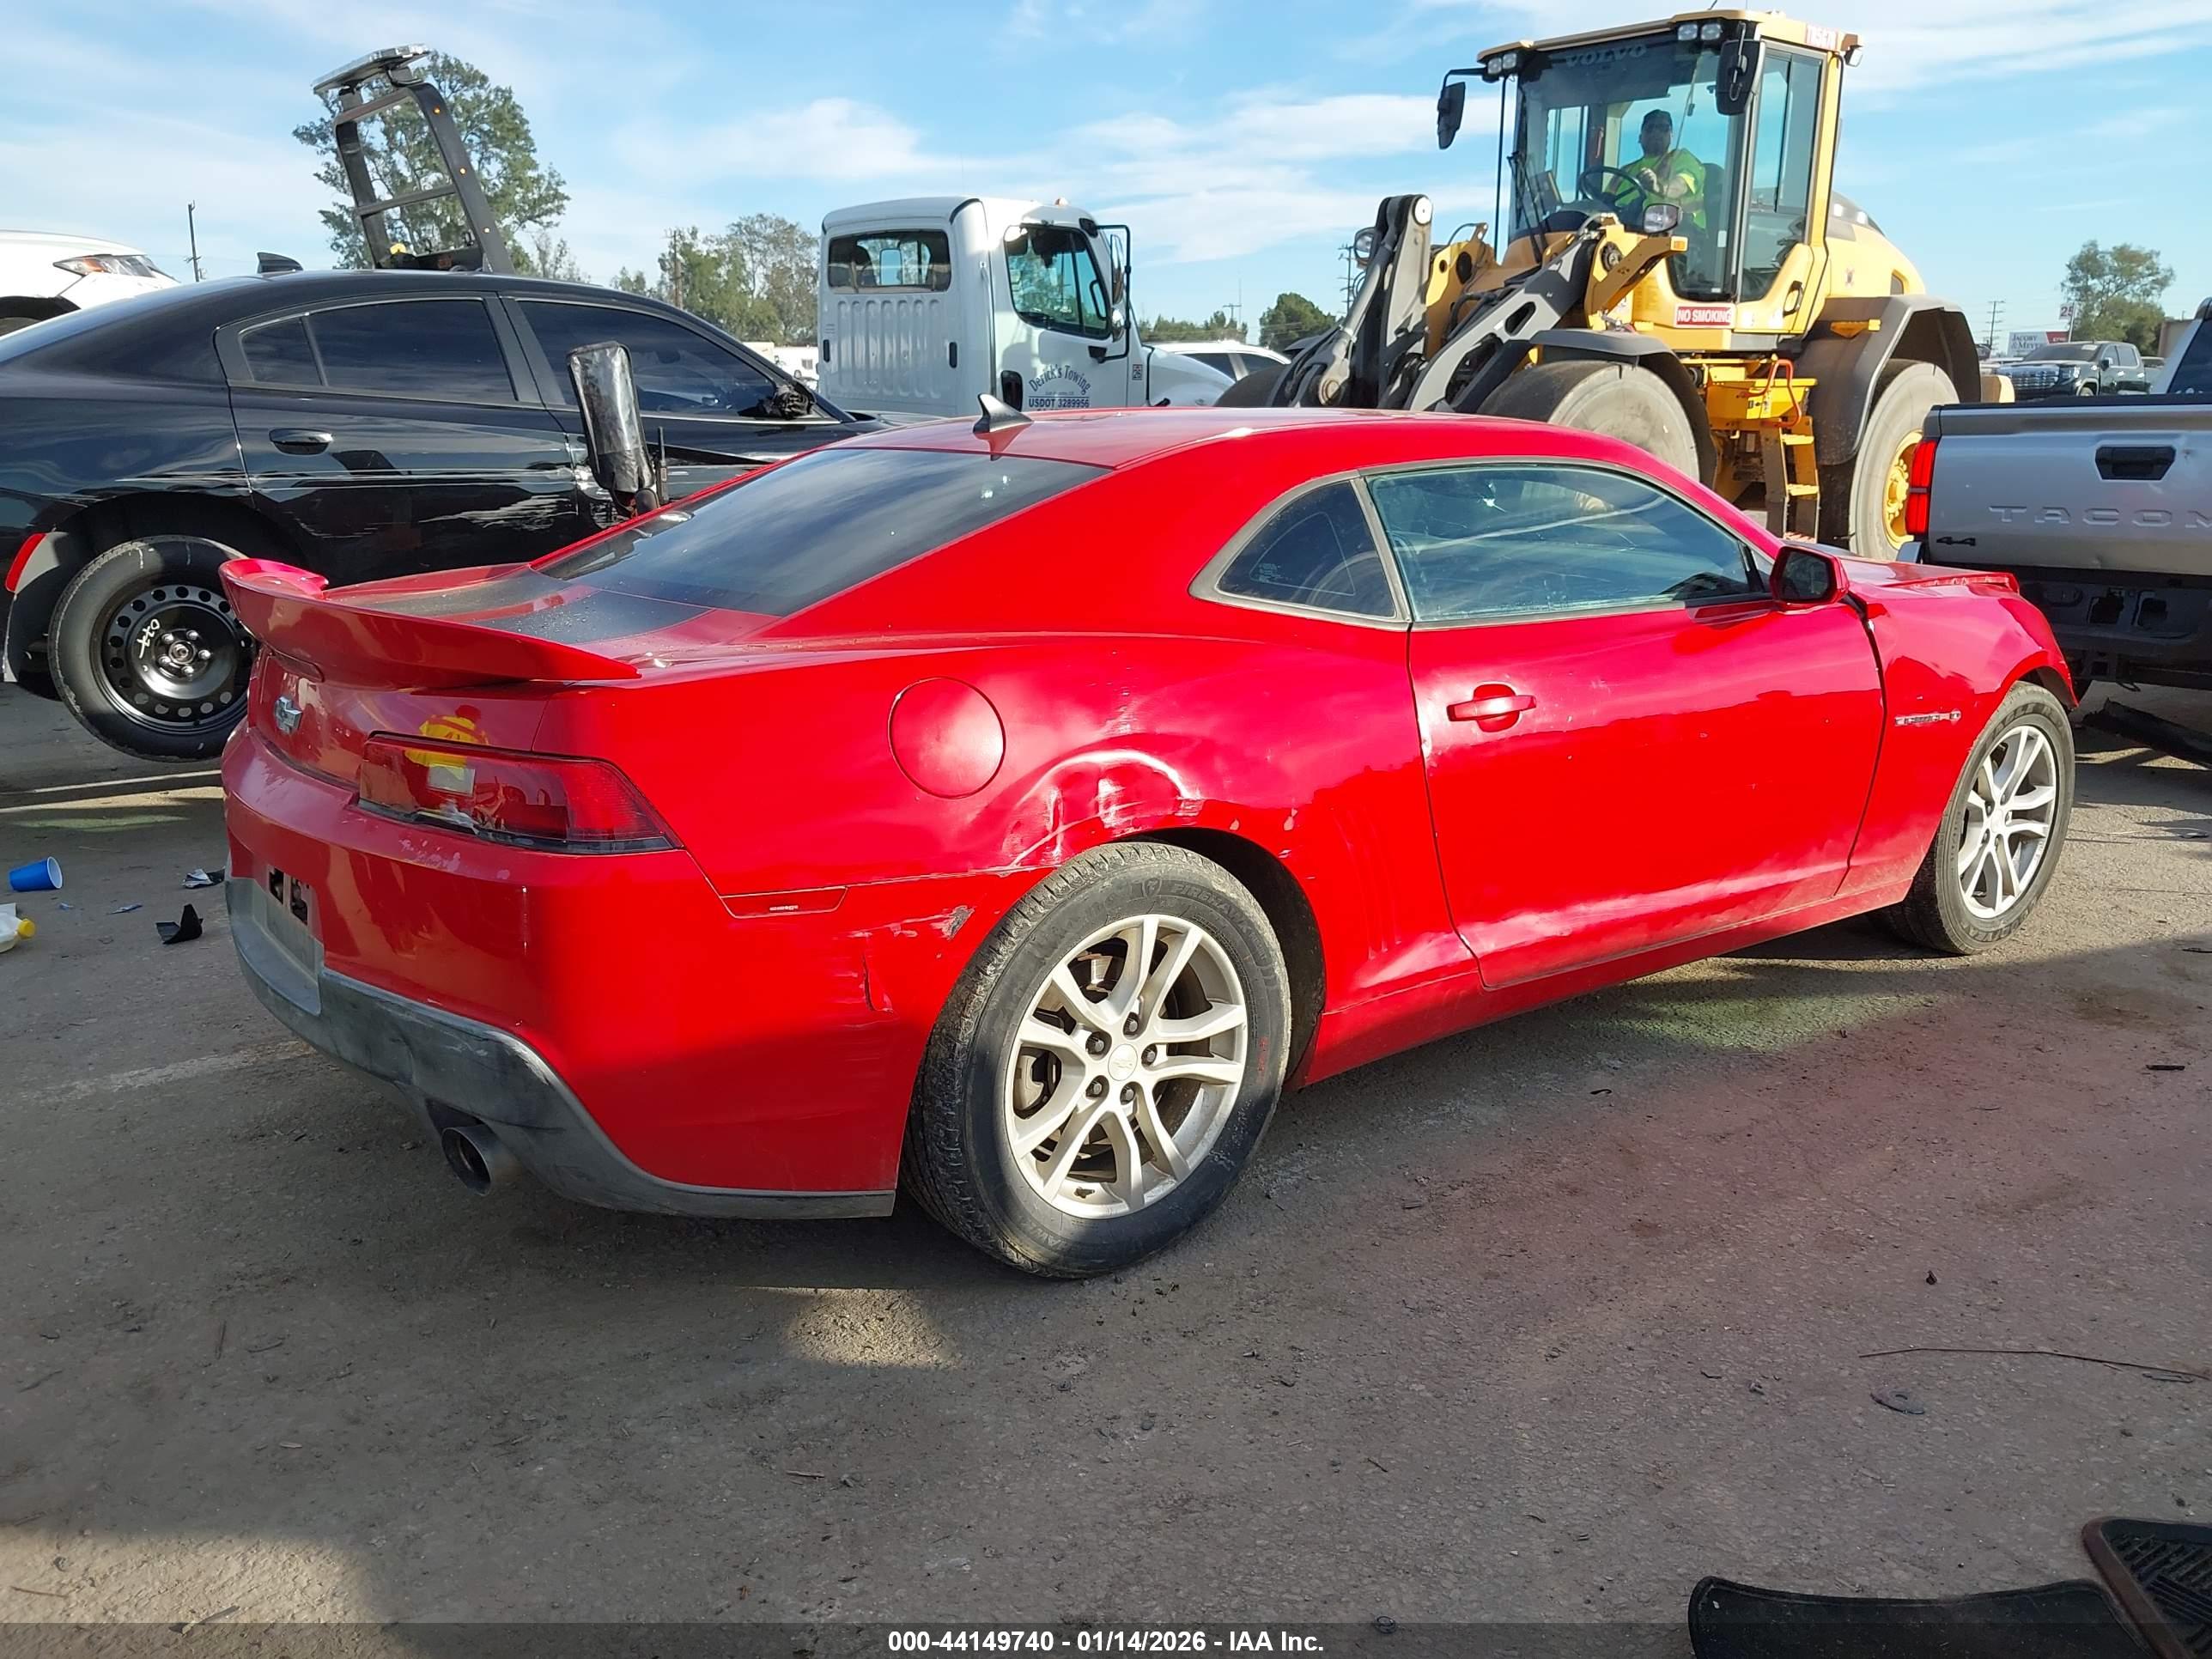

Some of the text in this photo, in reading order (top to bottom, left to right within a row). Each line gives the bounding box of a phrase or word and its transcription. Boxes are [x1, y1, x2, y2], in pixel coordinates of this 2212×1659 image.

[1566, 45, 1647, 67] VOLVO
[1677, 309, 1732, 323] NO SMOKING
[1064, 365, 1091, 396] Towing
[1029, 398, 1055, 408] USDOT
